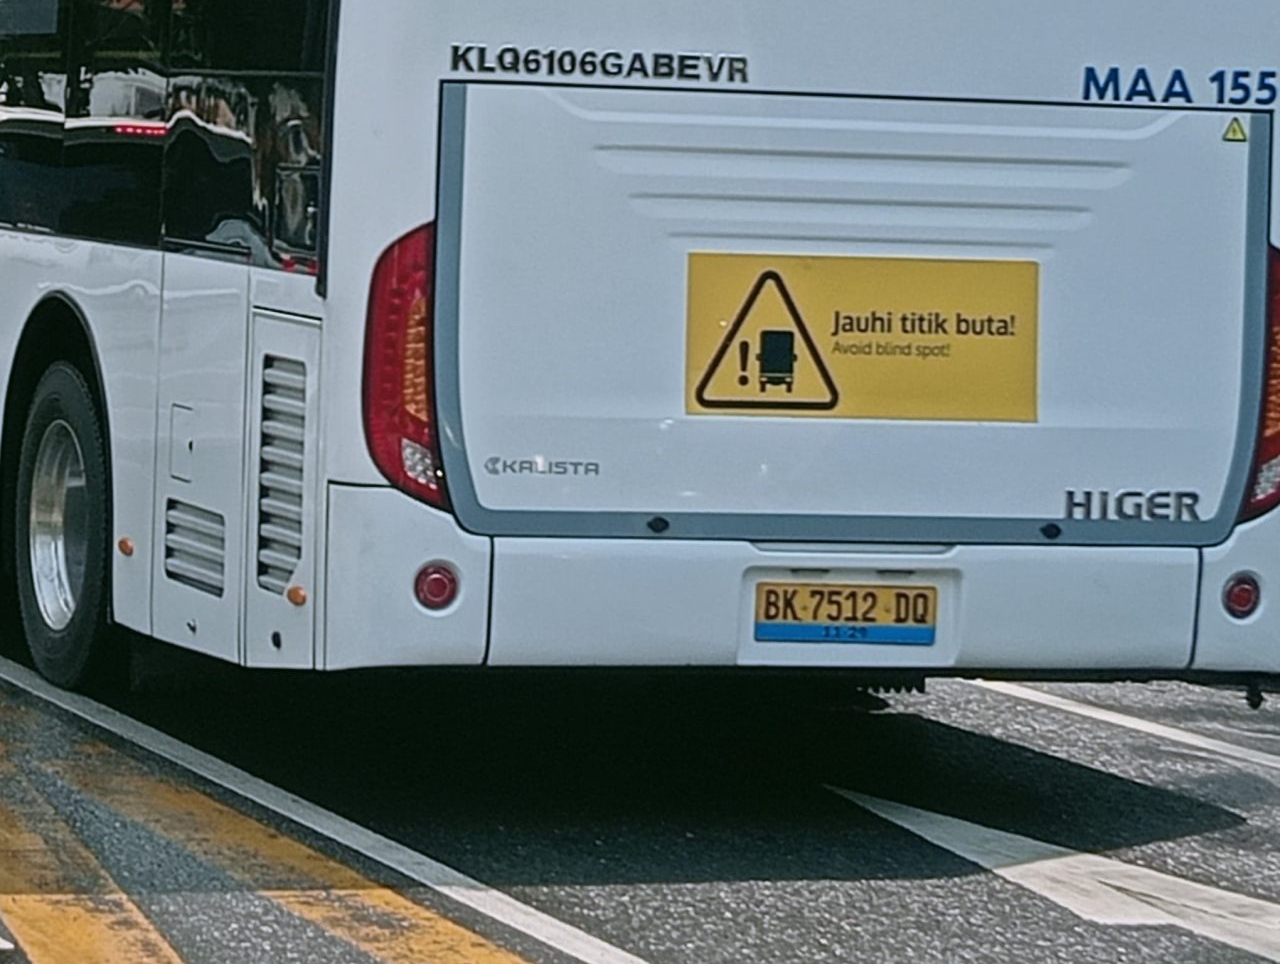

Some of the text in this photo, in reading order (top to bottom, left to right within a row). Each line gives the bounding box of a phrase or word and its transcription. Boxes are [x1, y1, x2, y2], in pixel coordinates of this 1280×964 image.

[450, 45, 749, 83] KLQ6106GABEVR
[1083, 66, 1277, 105] MAA 155
[831, 311, 1016, 336] Jauhi titik buta!
[832, 340, 951, 359] Avoid blind spot!
[502, 459, 600, 475] KALISTA
[1065, 490, 1201, 520] HIGER
[764, 589, 802, 622] BK
[809, 589, 877, 623] 7512
